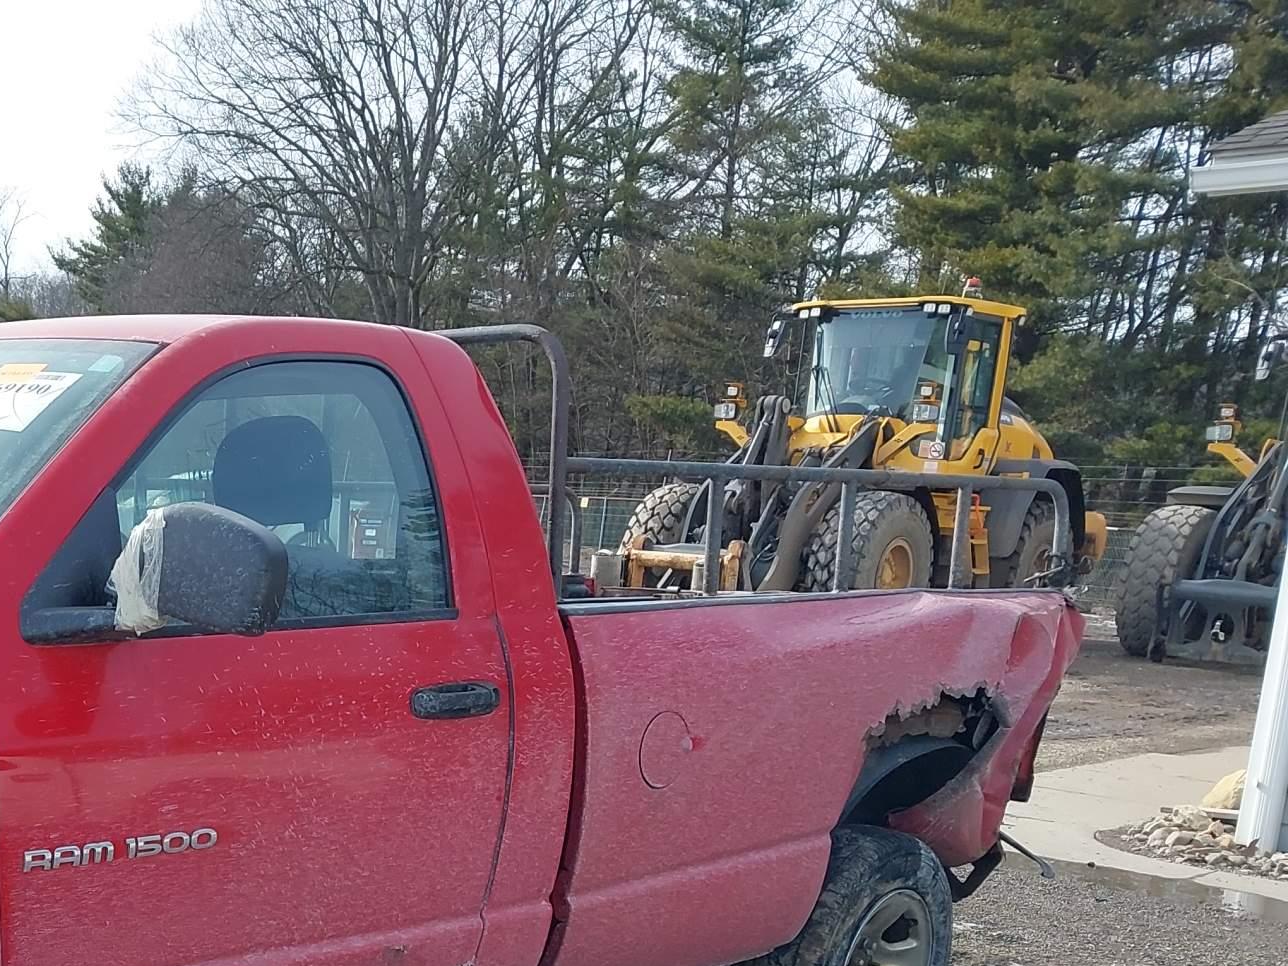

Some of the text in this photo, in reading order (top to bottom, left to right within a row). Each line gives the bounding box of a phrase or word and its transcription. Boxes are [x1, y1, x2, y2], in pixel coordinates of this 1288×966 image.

[851, 310, 904, 319] VOLVO
[23, 828, 218, 873] RAM 1500
